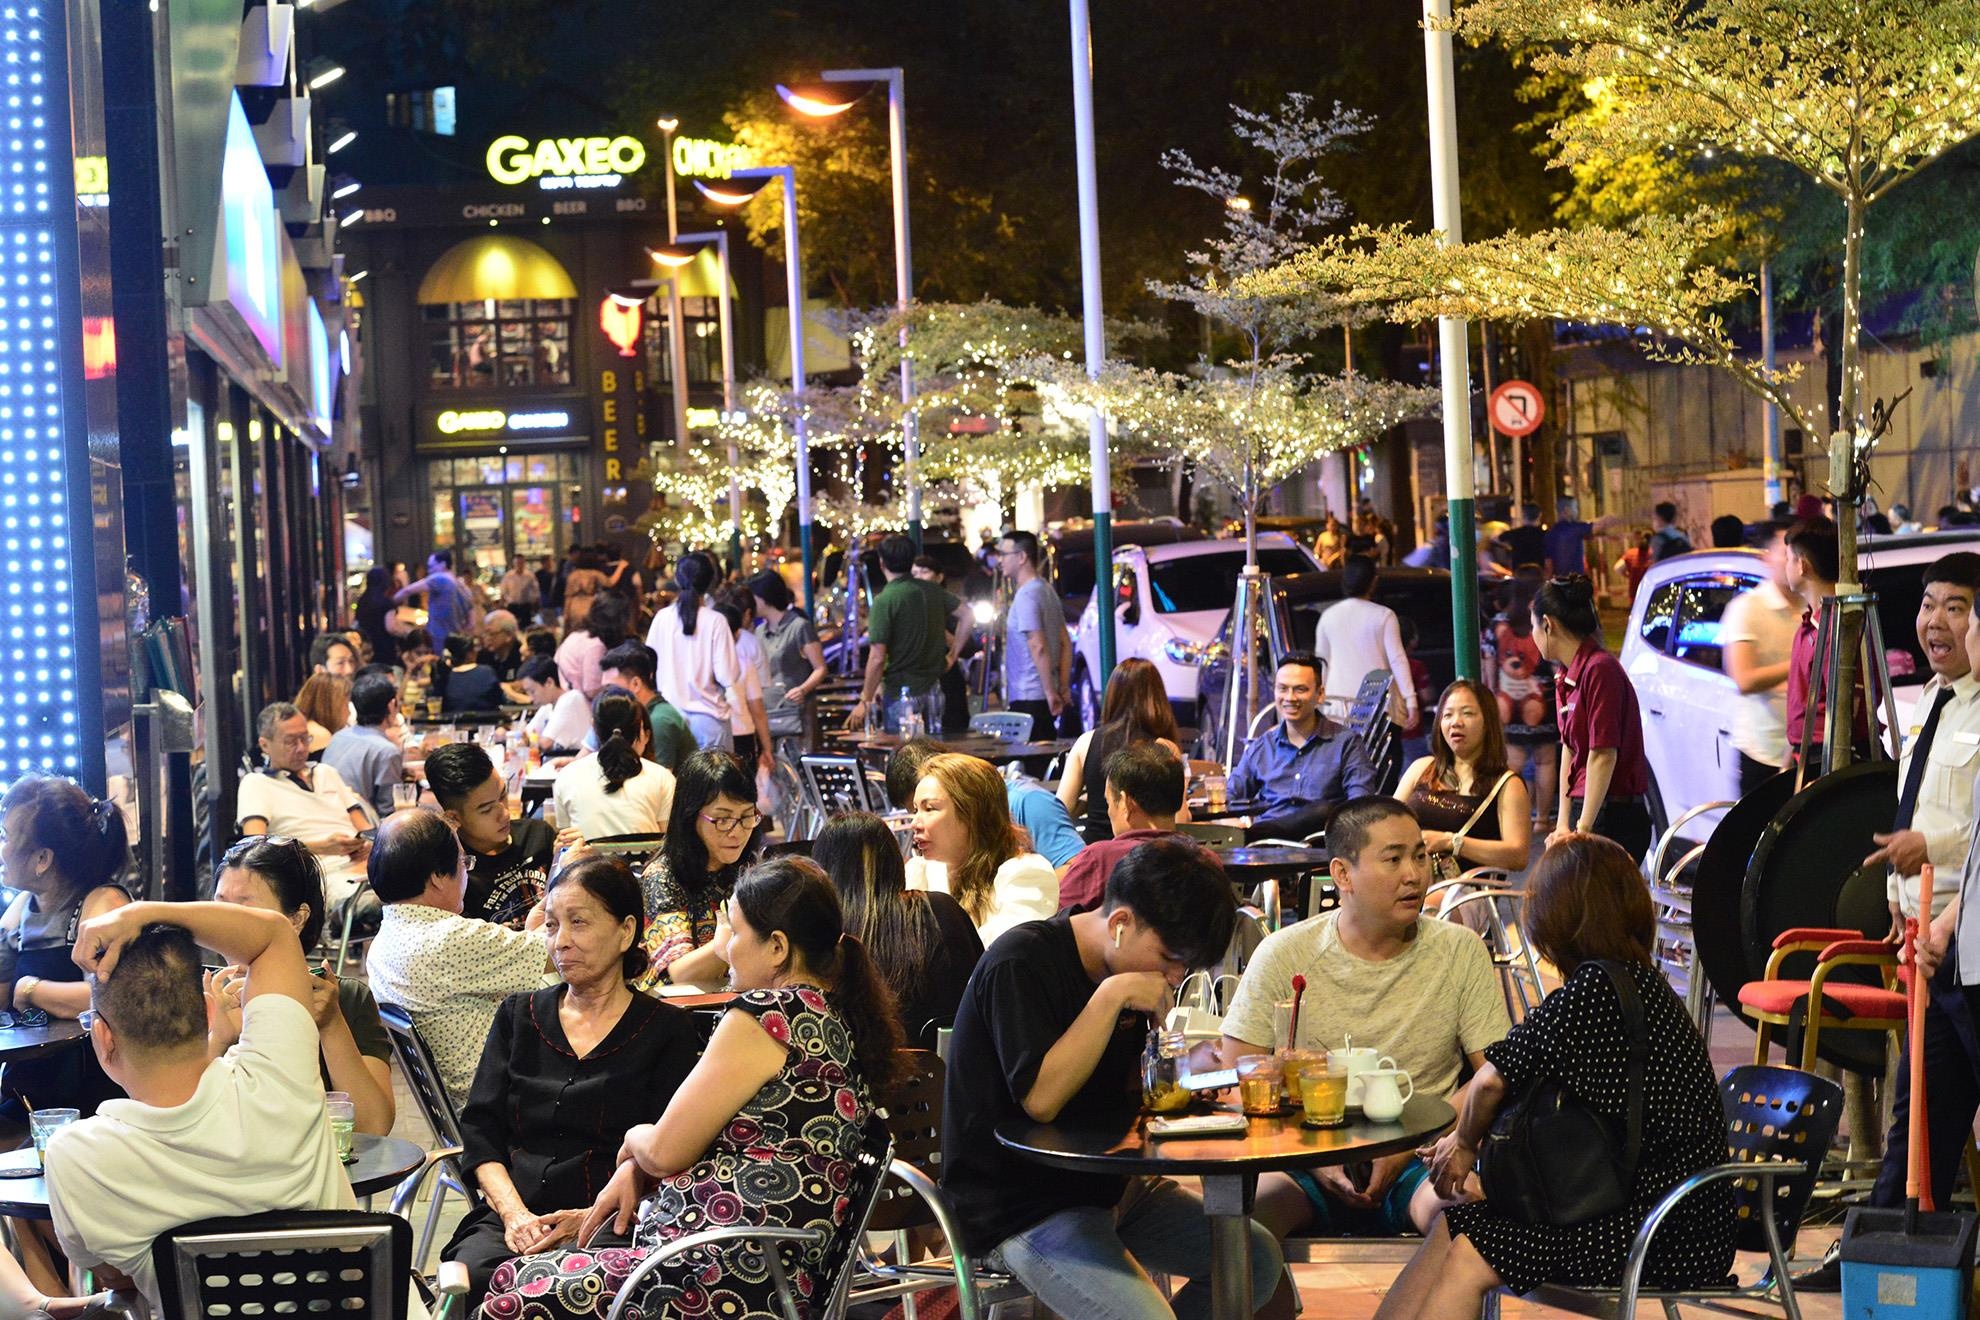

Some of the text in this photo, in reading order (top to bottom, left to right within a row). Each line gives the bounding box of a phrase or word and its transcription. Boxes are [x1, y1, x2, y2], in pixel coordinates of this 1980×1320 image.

[486, 135, 646, 185] GAXEO
[462, 203, 525, 218] CHICKEN
[553, 200, 587, 215] BEER
[602, 370, 621, 481] BEER
[483, 889, 502, 910] FREE
[499, 871, 523, 890] FROM
